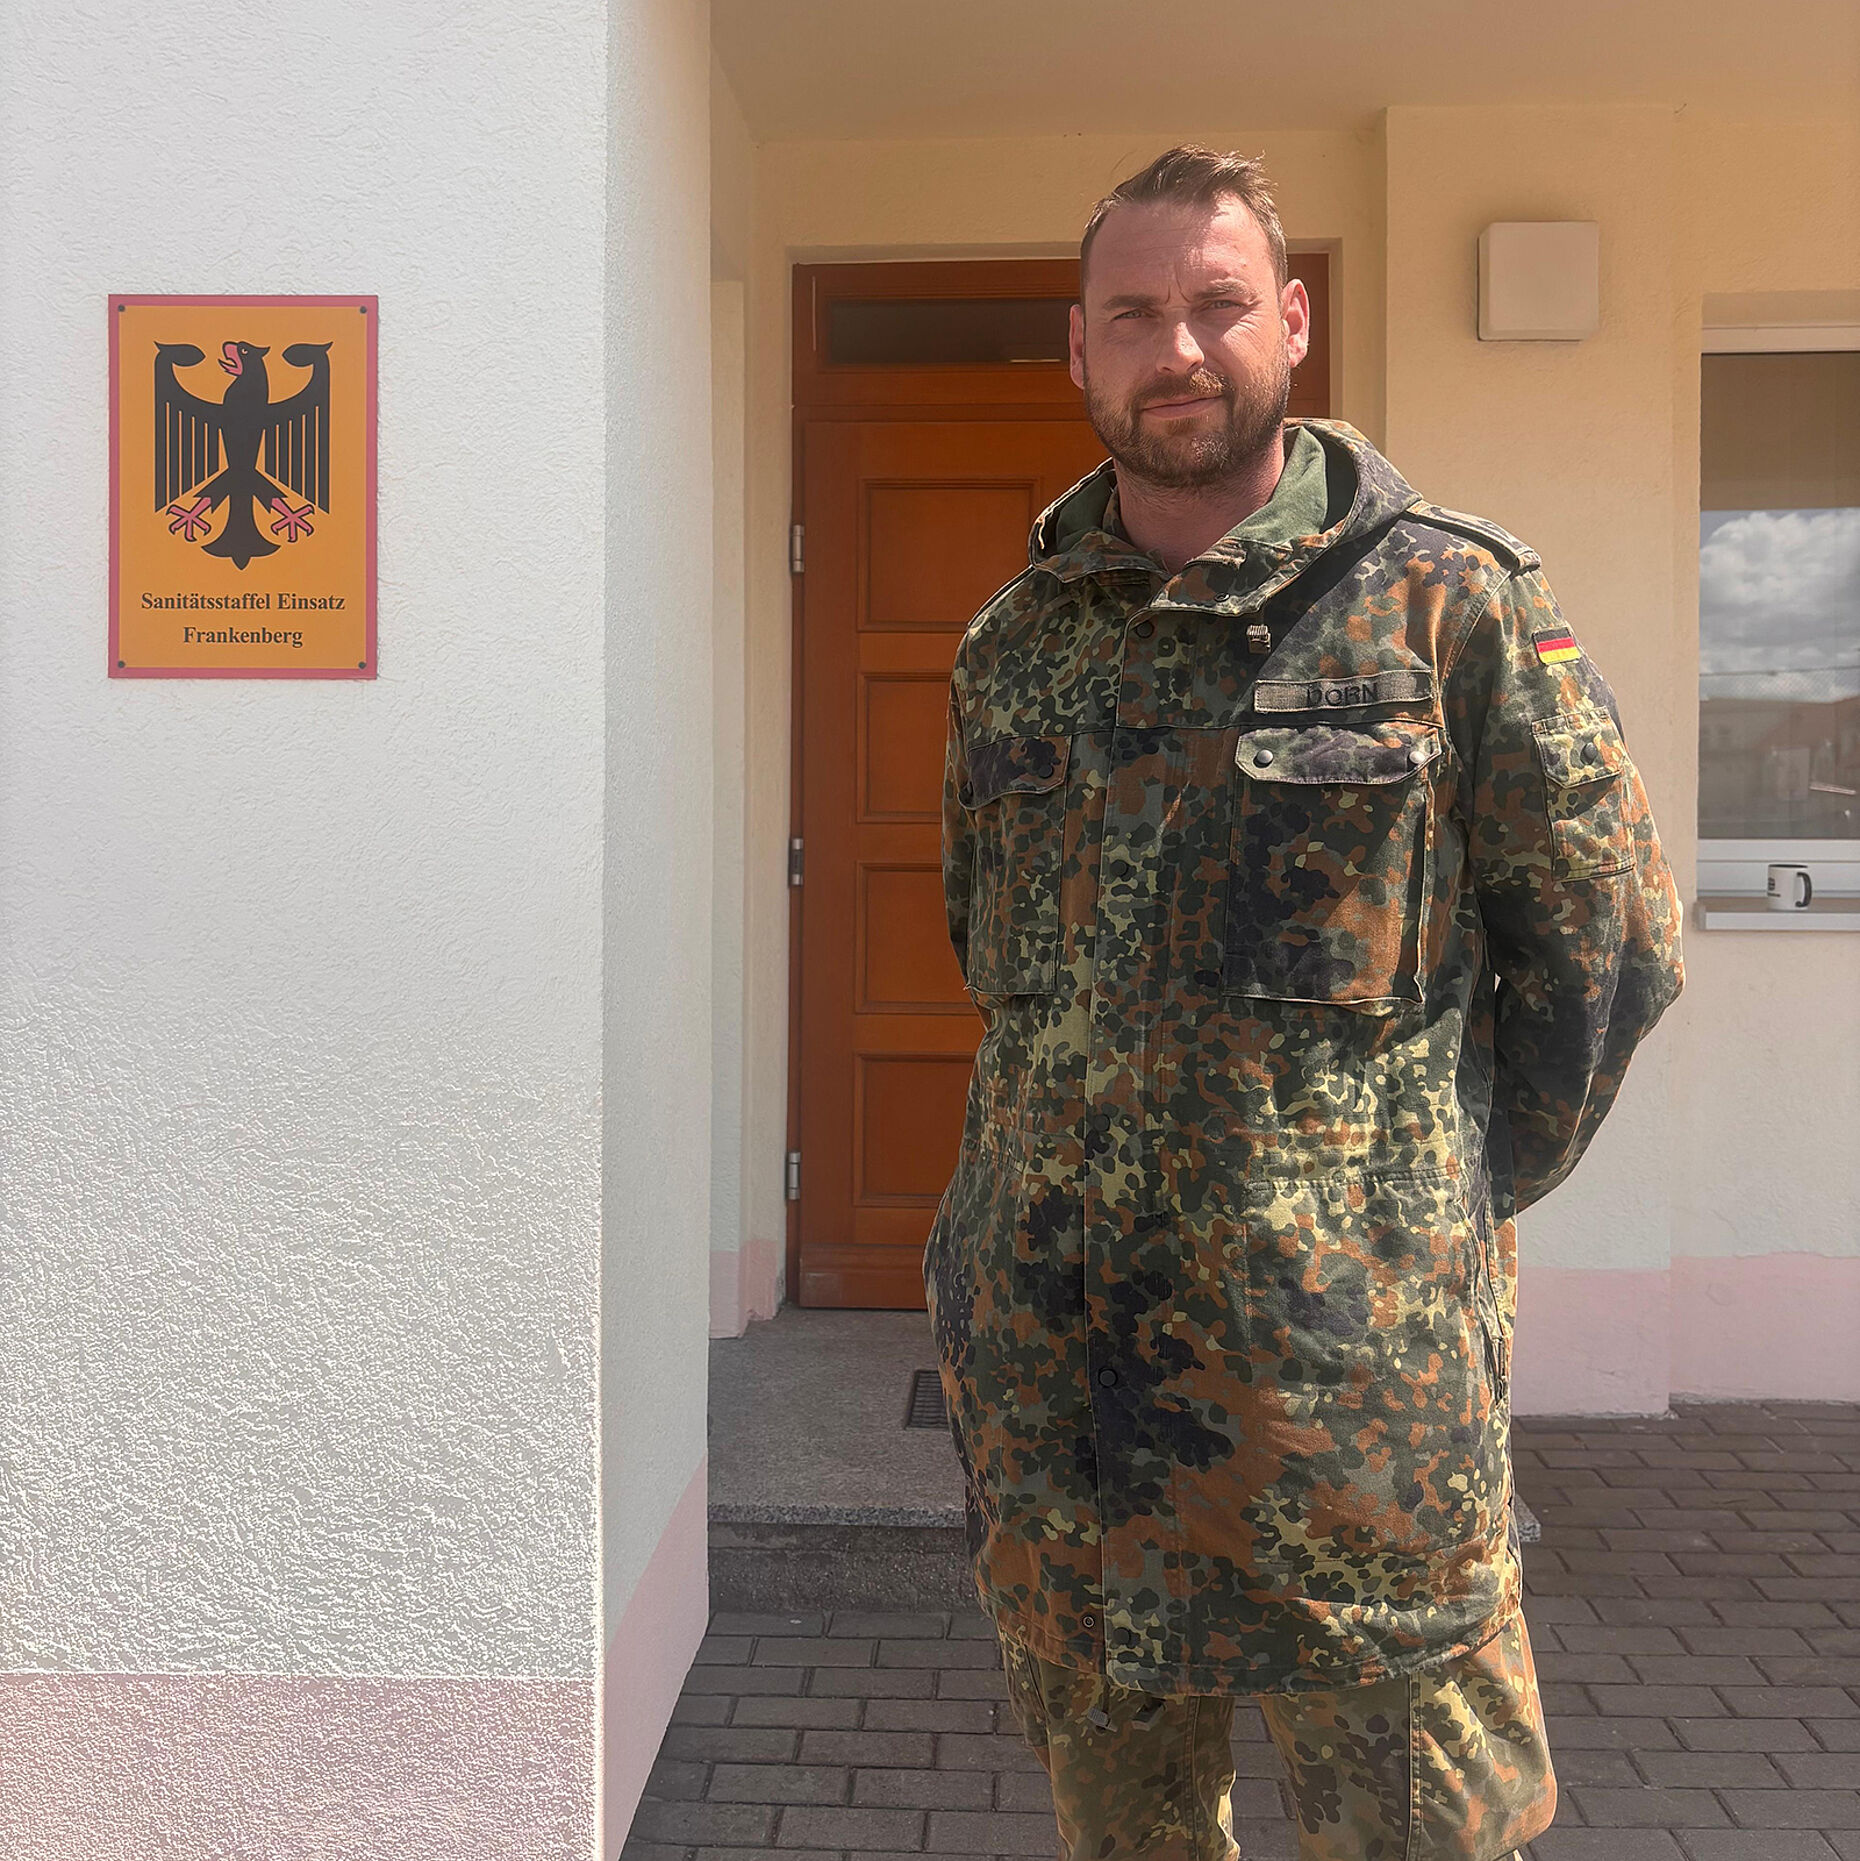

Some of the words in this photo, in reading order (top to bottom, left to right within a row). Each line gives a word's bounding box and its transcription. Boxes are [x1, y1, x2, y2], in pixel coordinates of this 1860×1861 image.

[141, 592, 271, 610] Sanitätsstaffel
[277, 593, 345, 610] Einsatz
[183, 626, 303, 648] Frankenberg
[1306, 683, 1378, 706] DORN
